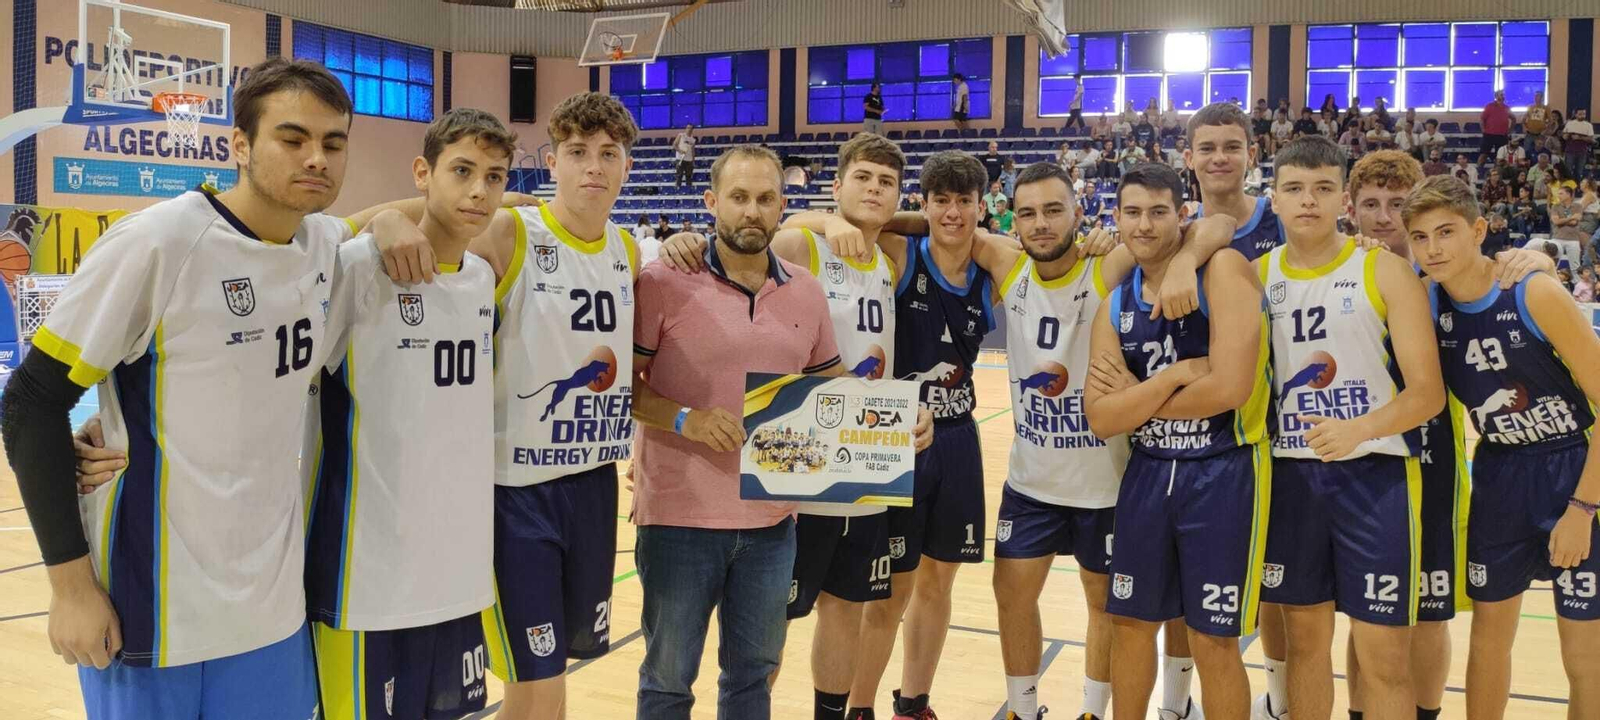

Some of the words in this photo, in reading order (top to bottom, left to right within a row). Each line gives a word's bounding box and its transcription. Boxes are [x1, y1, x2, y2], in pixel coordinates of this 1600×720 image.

[84, 125, 230, 162] ALGECIRAS
[569, 289, 617, 332] 20
[856, 296, 884, 334] 10
[1291, 306, 1327, 343] 12
[275, 317, 313, 379] 16
[1036, 316, 1060, 350] 0
[434, 340, 476, 387] 00
[1465, 337, 1508, 372] 43
[864, 397, 883, 408] CADETE
[1297, 386, 1370, 412] ENER
[1493, 399, 1571, 433] ENER
[551, 418, 632, 444] DRINK
[1487, 412, 1579, 446] DRINK
[513, 445, 593, 466] ENERGY
[854, 452, 869, 461] COPA
[870, 452, 902, 463] PRIMAVERA
[964, 523, 975, 545] 1
[869, 554, 891, 583] 10
[1556, 569, 1597, 599] 43
[1202, 582, 1239, 613] 23
[1363, 572, 1400, 602] 12
[462, 643, 485, 688] 00
